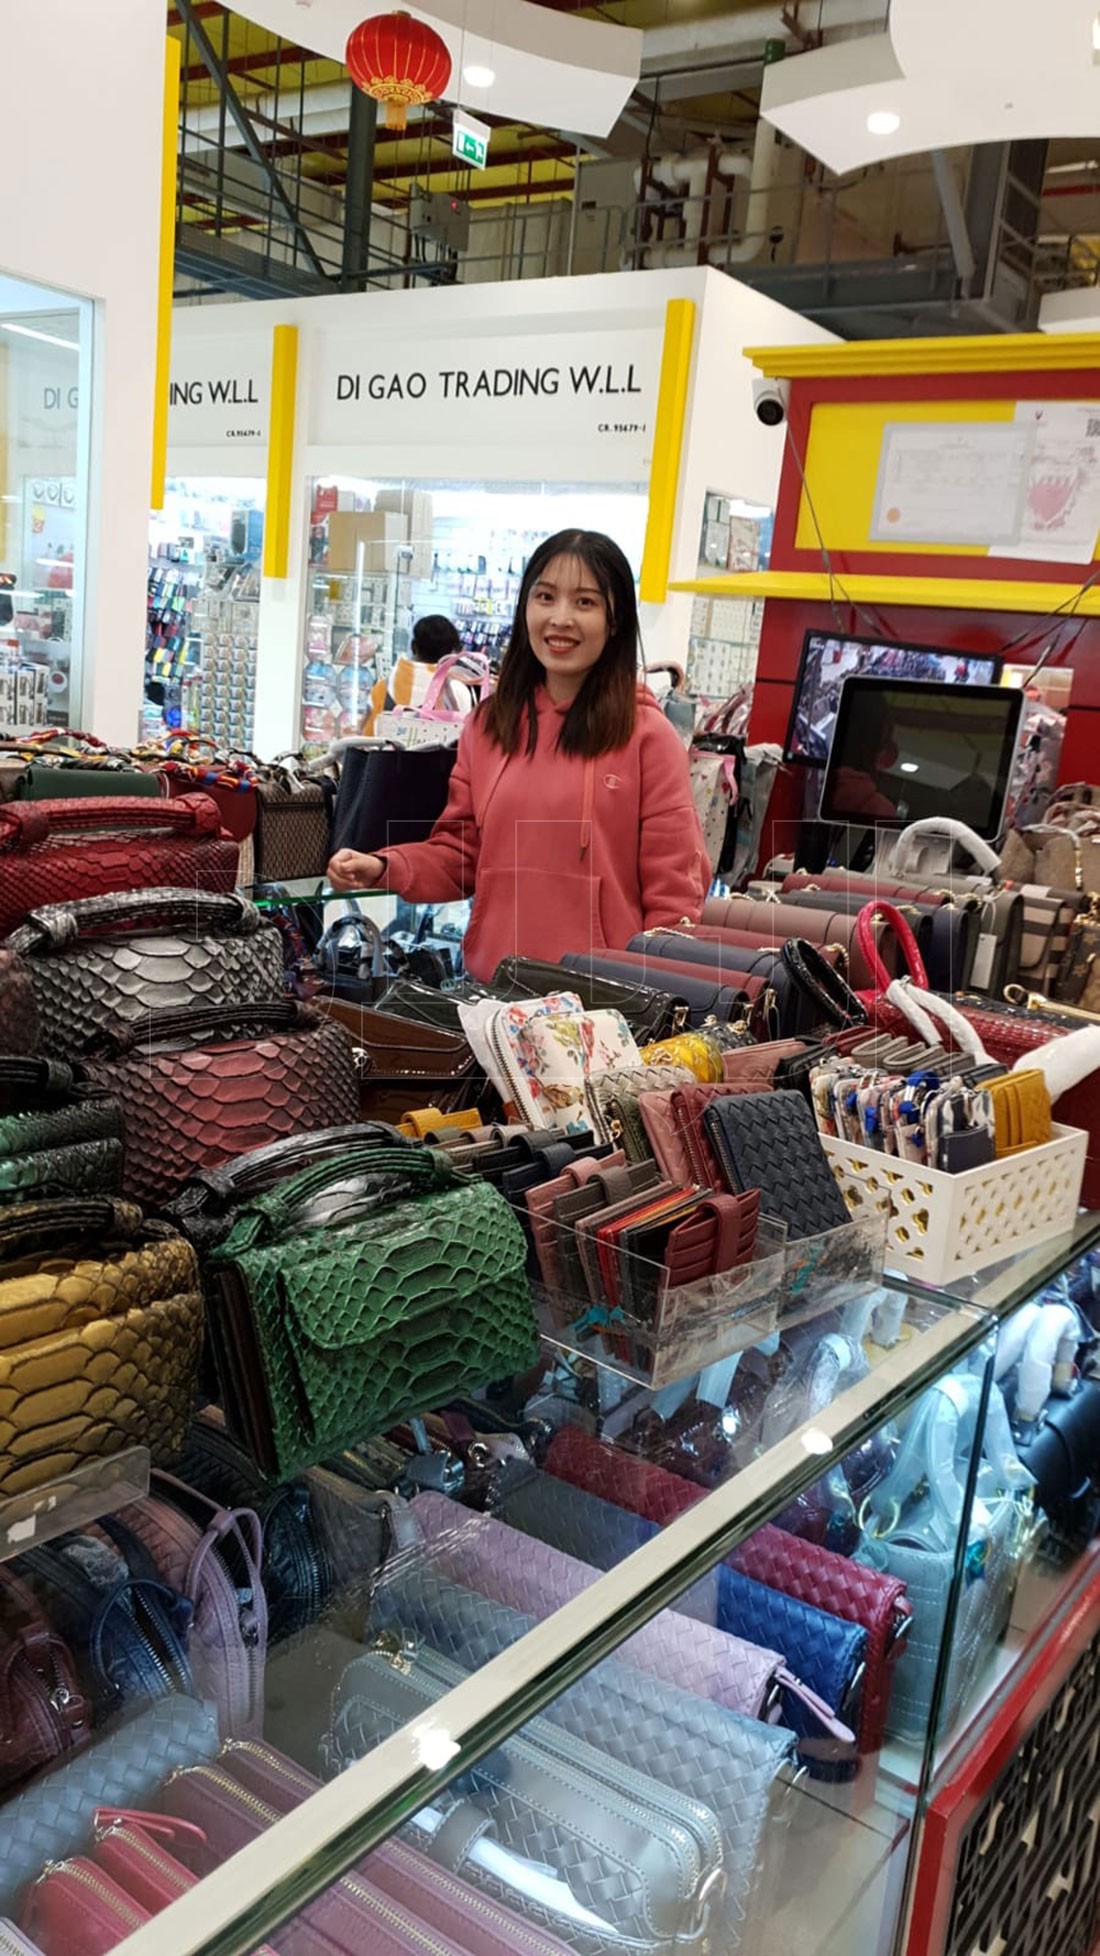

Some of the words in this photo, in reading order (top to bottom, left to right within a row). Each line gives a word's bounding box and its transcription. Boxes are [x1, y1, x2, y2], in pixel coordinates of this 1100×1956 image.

[338, 374, 360, 400] DI
[368, 372, 427, 399] GAO
[439, 366, 560, 398] TRADING
[569, 363, 642, 394] W.L.L
